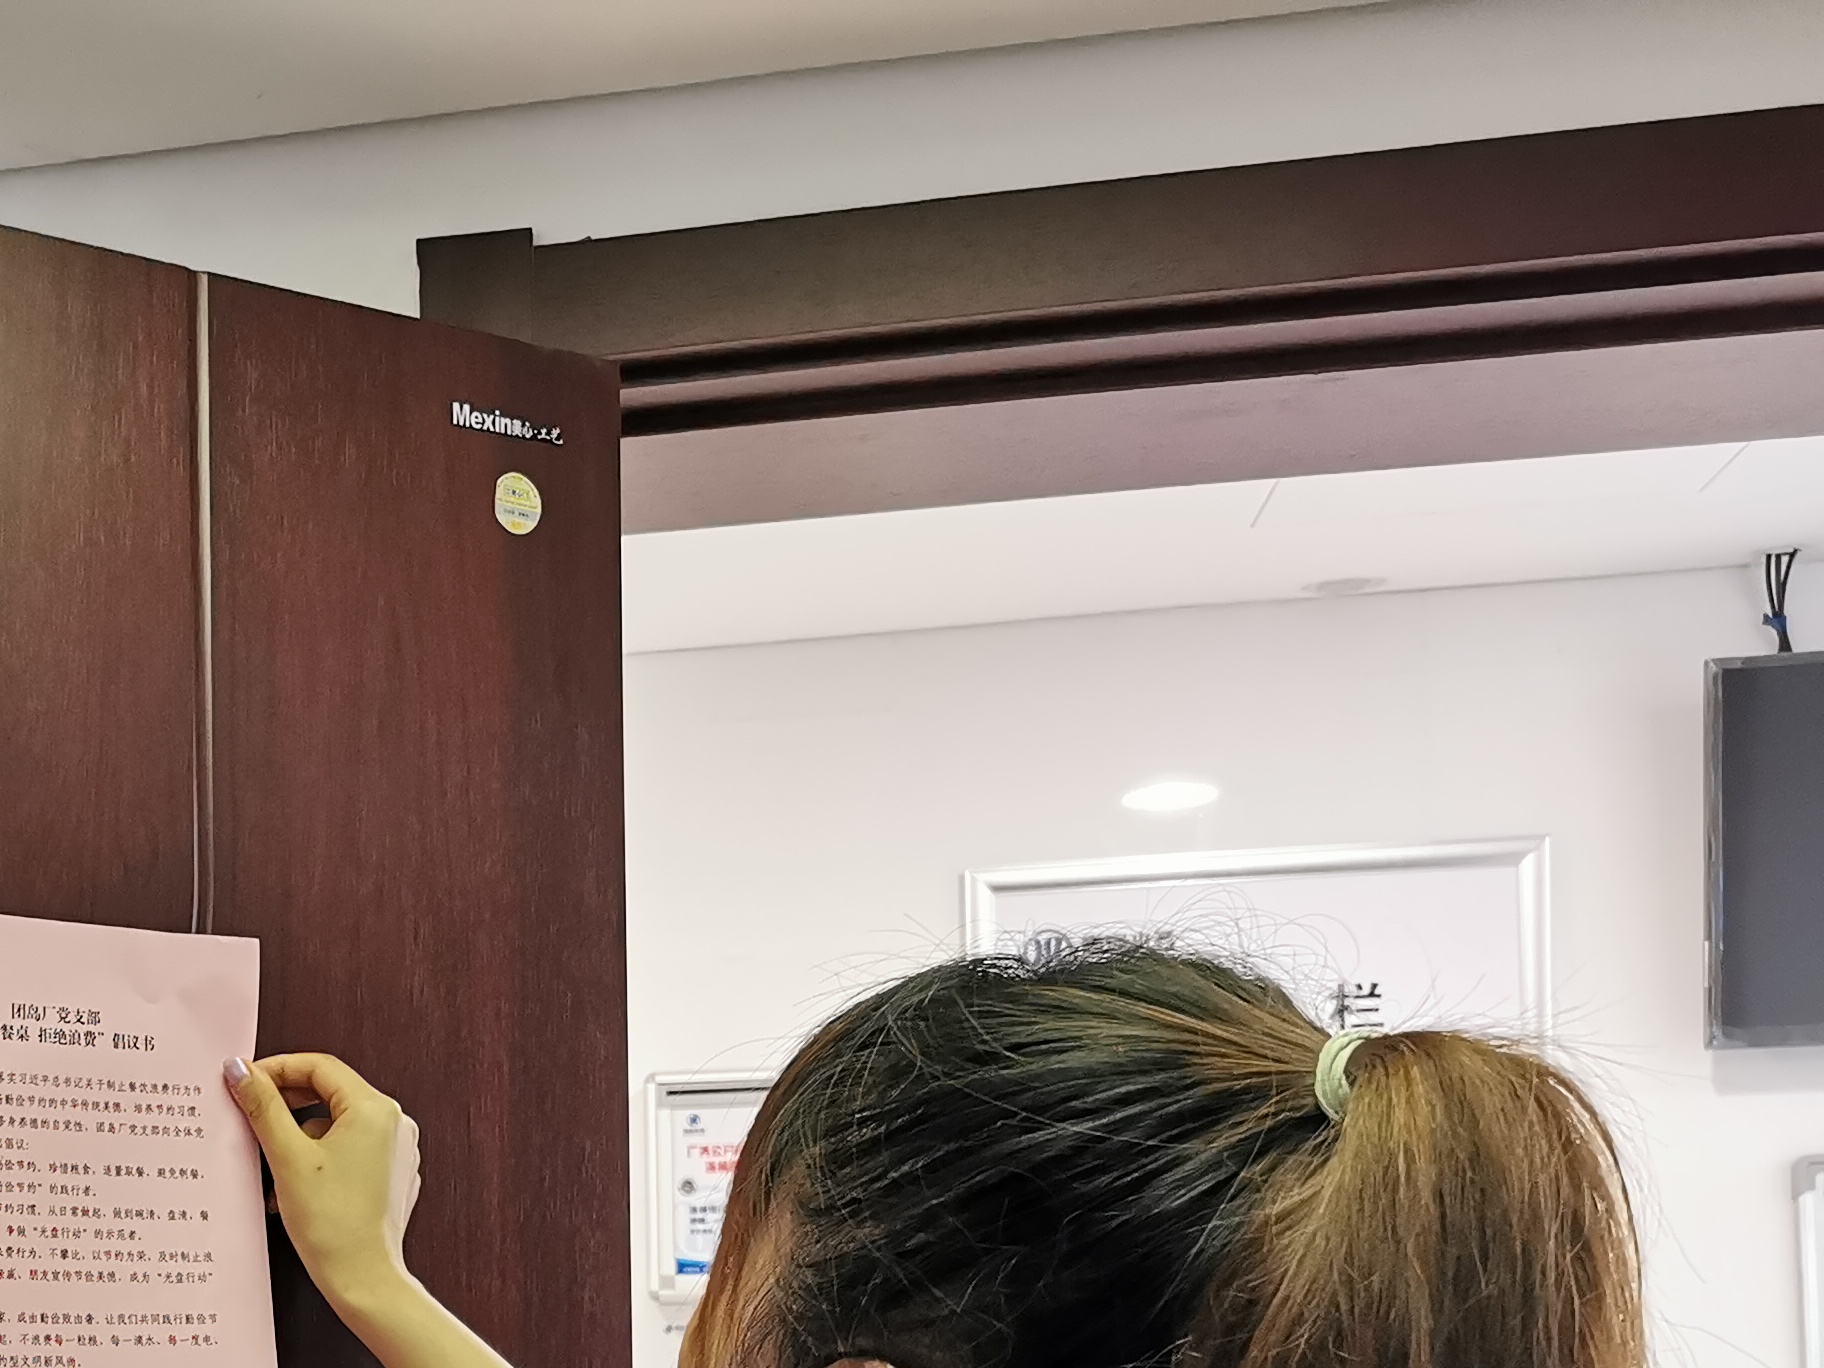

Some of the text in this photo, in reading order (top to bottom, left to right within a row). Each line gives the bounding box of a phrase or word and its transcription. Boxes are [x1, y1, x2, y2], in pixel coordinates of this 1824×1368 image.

[10, 1002, 102, 1027] 团岛厂党支部
